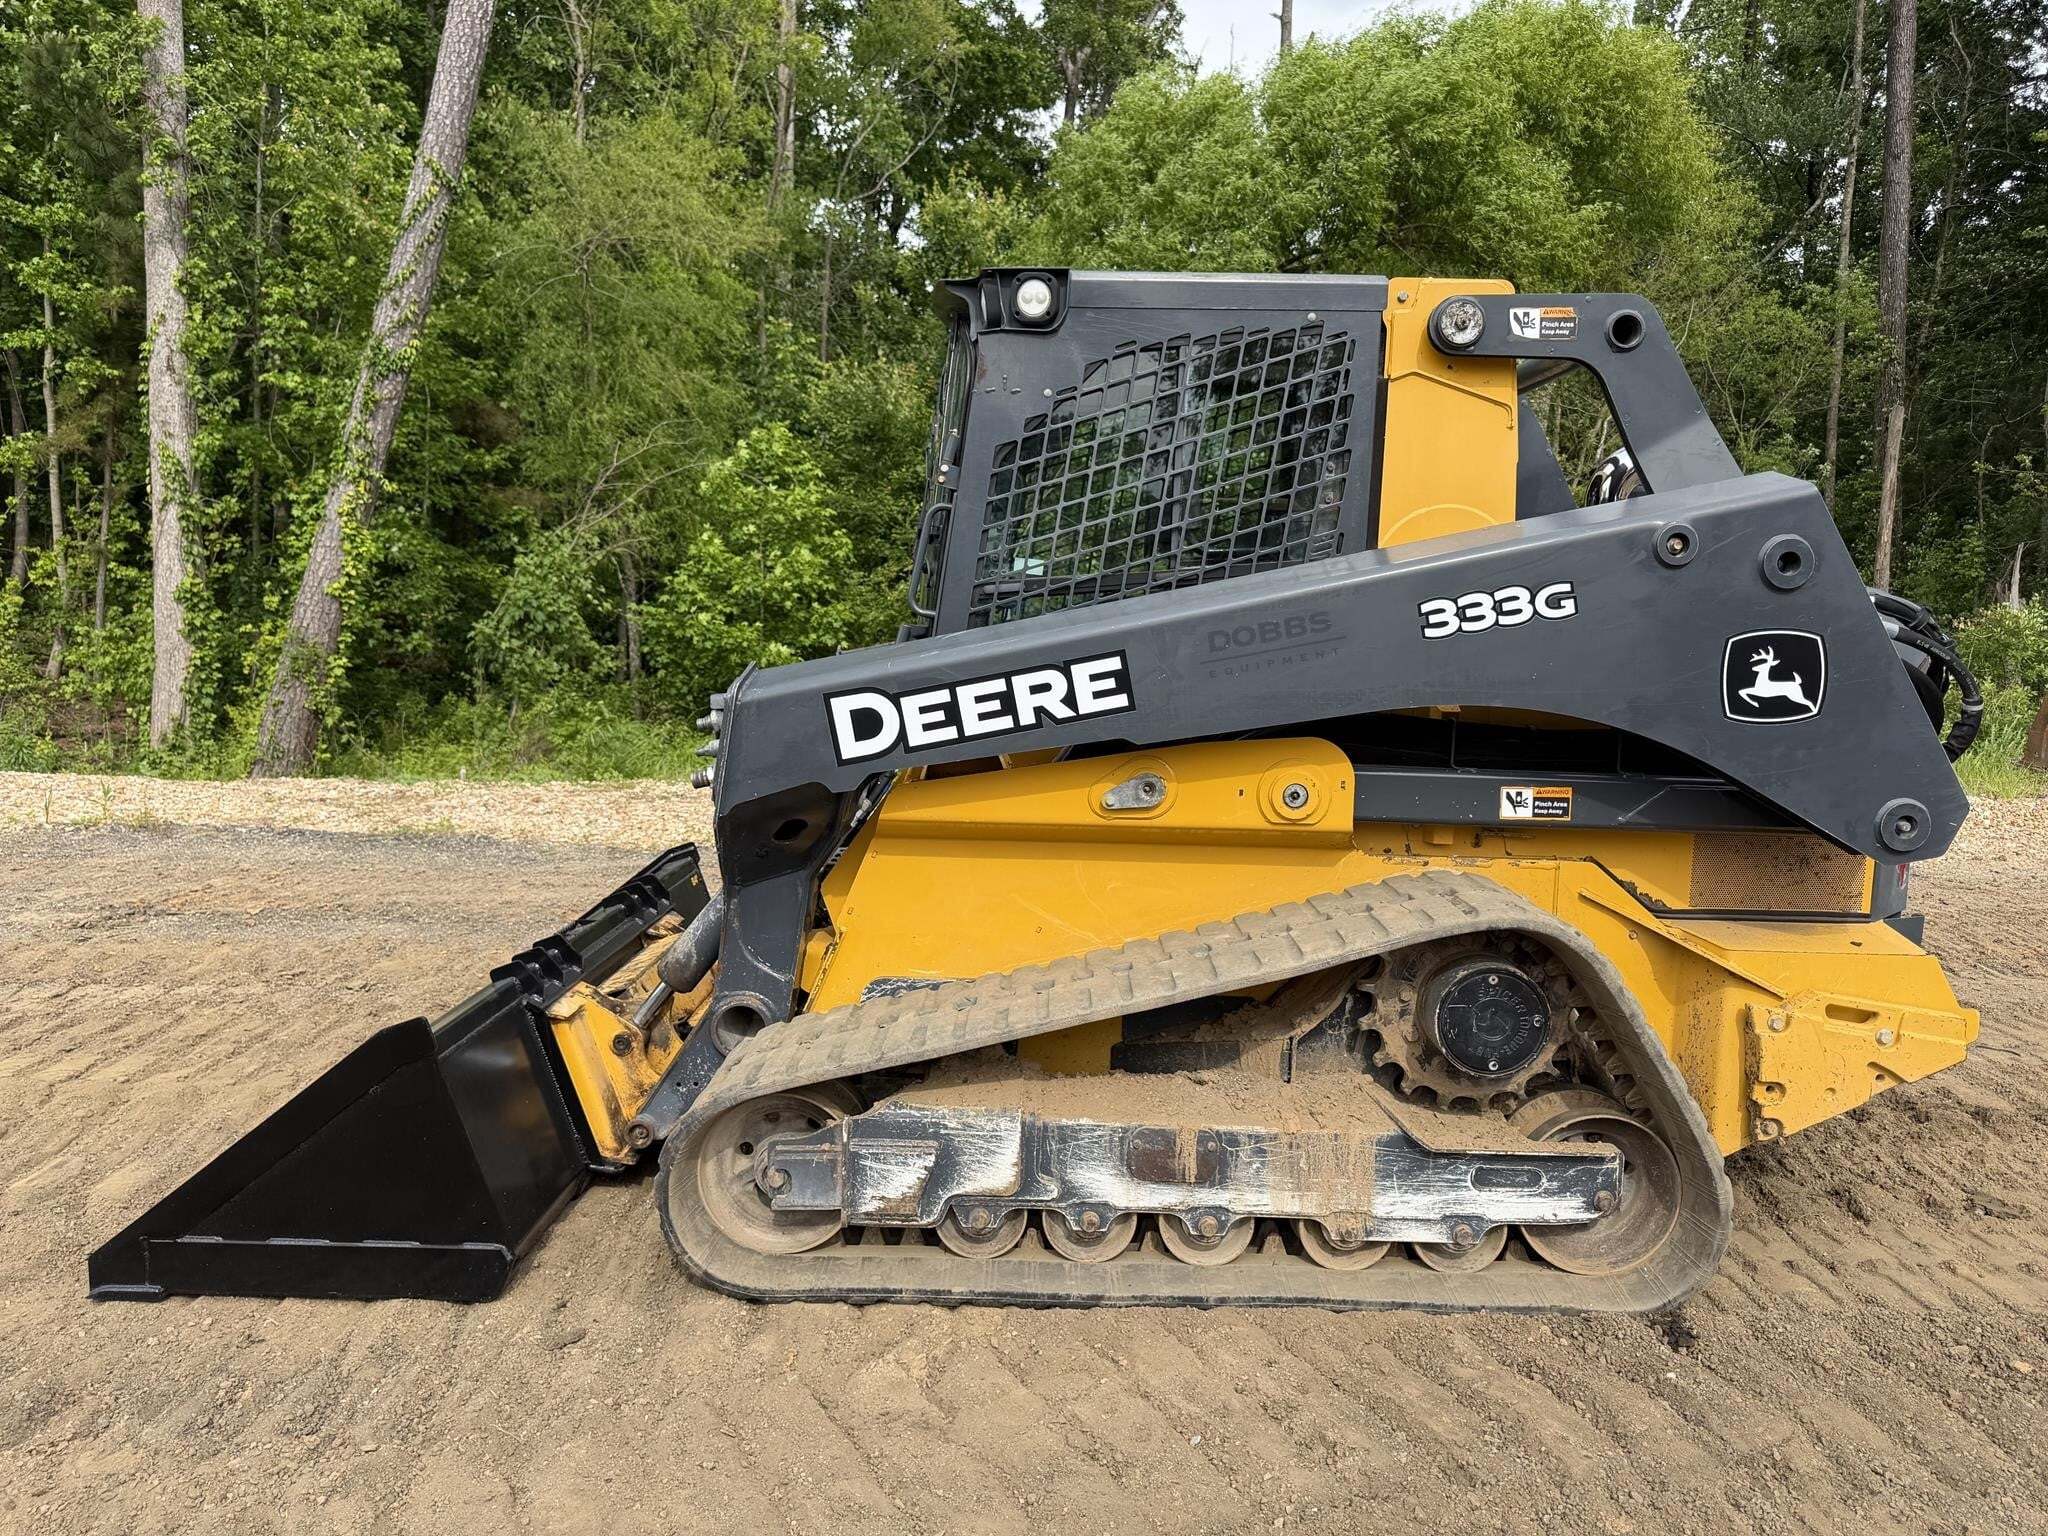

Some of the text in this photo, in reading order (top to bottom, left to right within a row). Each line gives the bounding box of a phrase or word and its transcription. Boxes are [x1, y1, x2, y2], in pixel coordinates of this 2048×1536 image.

[1207, 611, 1333, 653] DOBBS
[1419, 582, 1577, 639] 333G
[1208, 647, 1340, 680] EQUIPMENT
[829, 655, 1130, 761] DEERE
